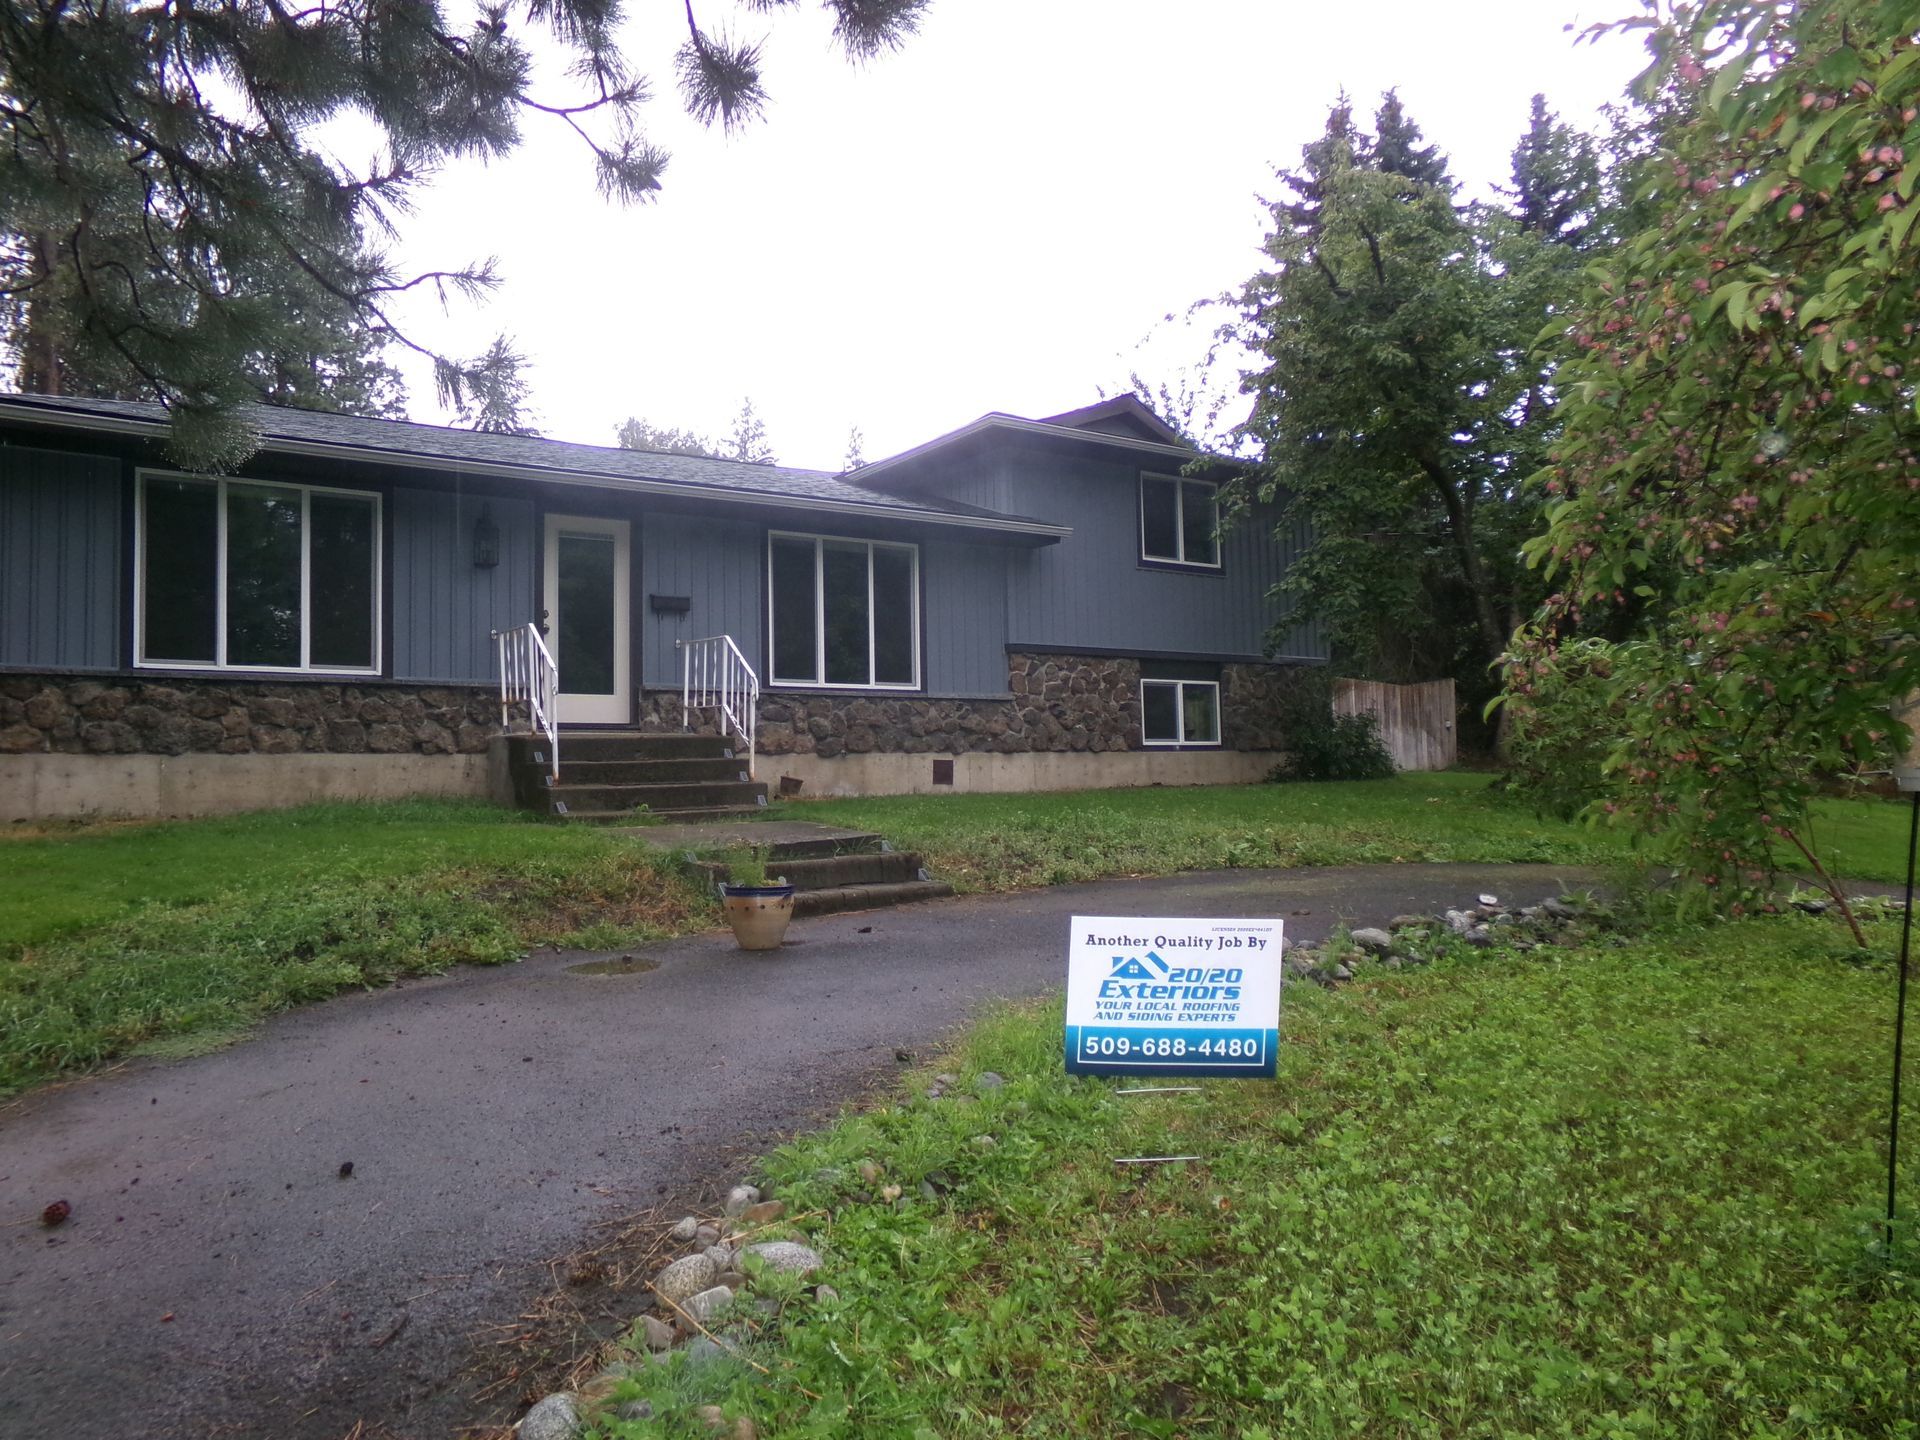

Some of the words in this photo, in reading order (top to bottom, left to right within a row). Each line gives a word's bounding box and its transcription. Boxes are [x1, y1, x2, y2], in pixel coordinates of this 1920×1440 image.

[1086, 934, 1149, 947] Another
[1155, 936, 1213, 949] Quality
[1218, 937, 1242, 949] Job
[1248, 937, 1267, 950] By
[1168, 968, 1243, 984] 20/20
[1098, 980, 1241, 1000] Exteriors
[1095, 1001, 1131, 1010] YOUR
[1137, 1002, 1177, 1011] LOCAL
[1183, 1003, 1240, 1011] ROOFING
[1093, 1012, 1123, 1020] AND
[1128, 1013, 1172, 1021] SIDING
[1178, 1013, 1236, 1022] EXPERTS
[1086, 1037, 1257, 1057] 509-688-4480
